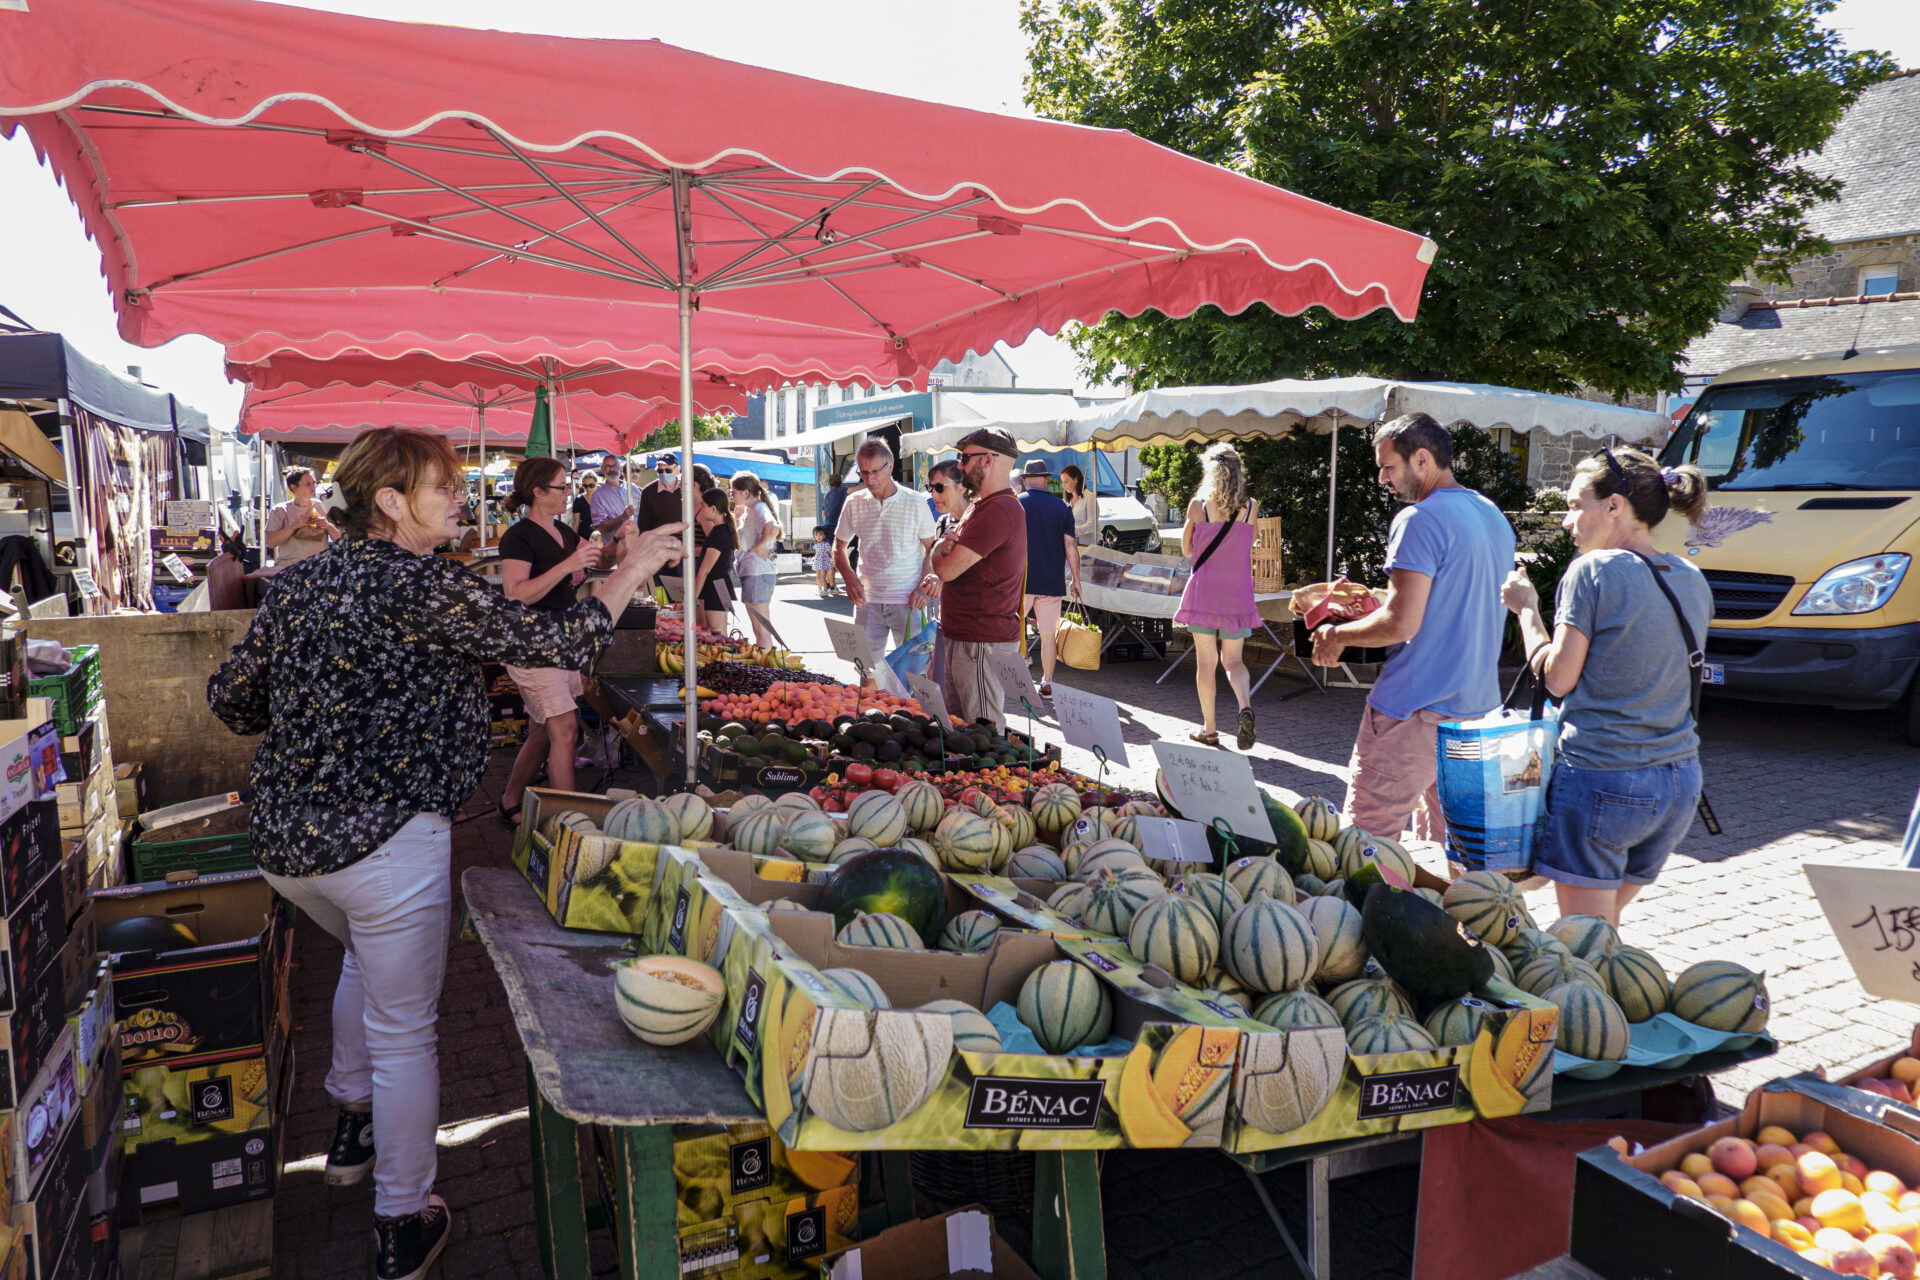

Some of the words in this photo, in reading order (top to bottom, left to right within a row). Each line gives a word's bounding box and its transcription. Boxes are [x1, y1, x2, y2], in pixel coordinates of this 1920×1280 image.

[765, 770, 799, 782] Sublime
[981, 1087, 1090, 1116] BÉNAC
[1369, 1081, 1450, 1107] BÉNAC
